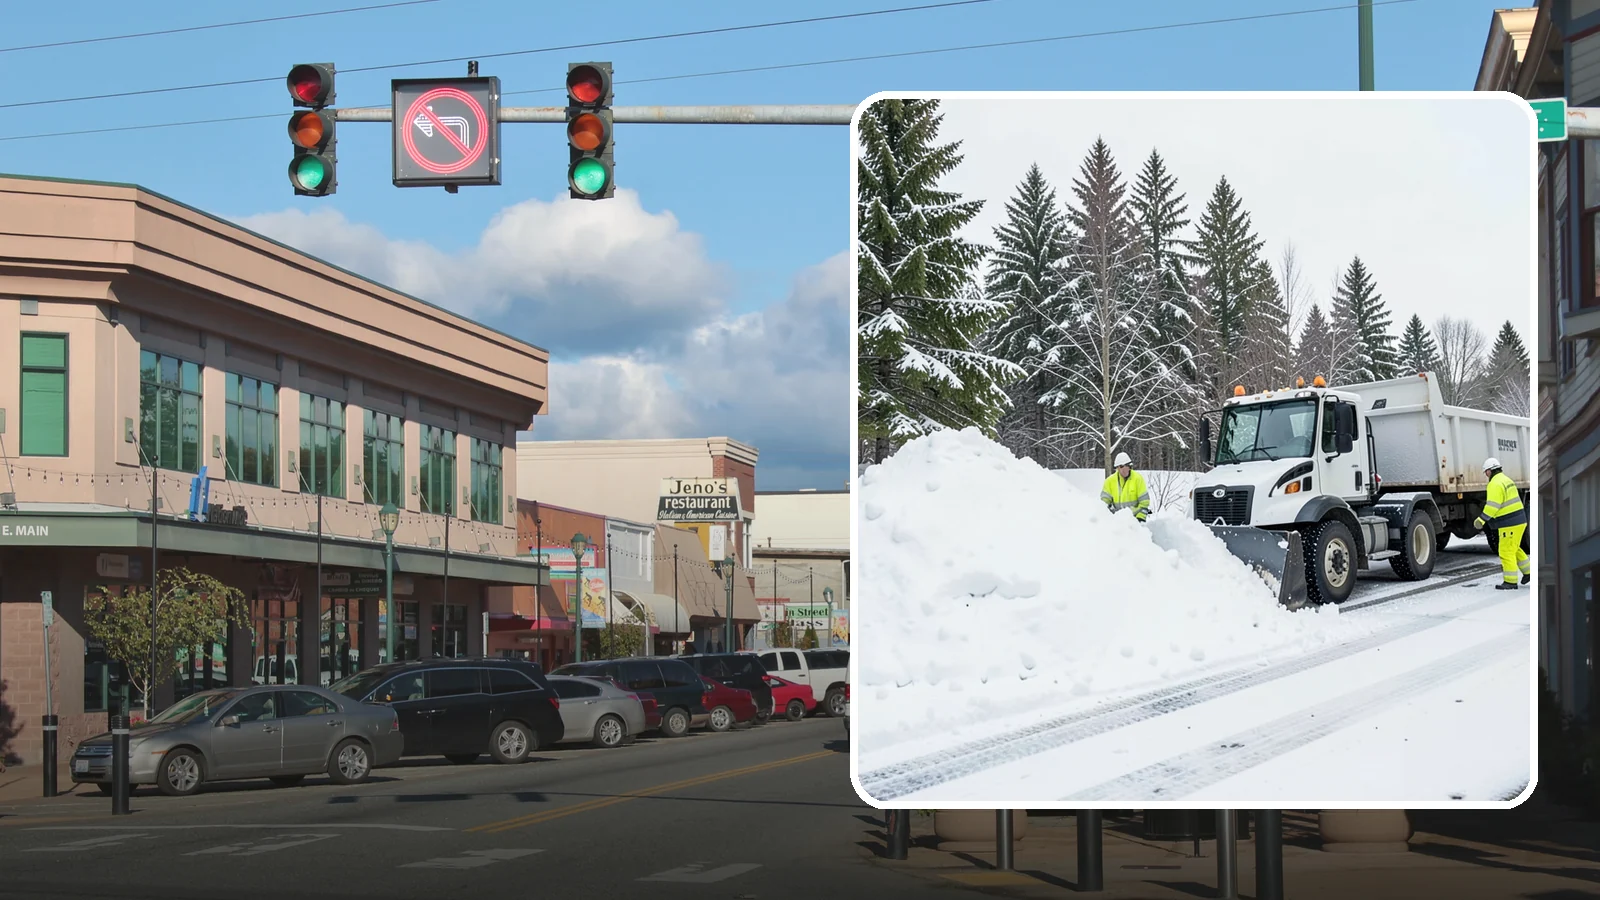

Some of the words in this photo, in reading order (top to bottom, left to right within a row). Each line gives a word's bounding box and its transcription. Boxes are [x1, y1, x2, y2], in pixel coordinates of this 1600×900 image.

[669, 480, 728, 495] Jeno's
[665, 497, 731, 509] restaurant
[658, 510, 682, 520] Italian
[686, 510, 714, 519] American
[715, 509, 737, 519] Cuisine
[2, 525, 13, 536] E.
[15, 525, 49, 536] MAIN
[797, 608, 828, 617] Street
[791, 619, 824, 627] lass
